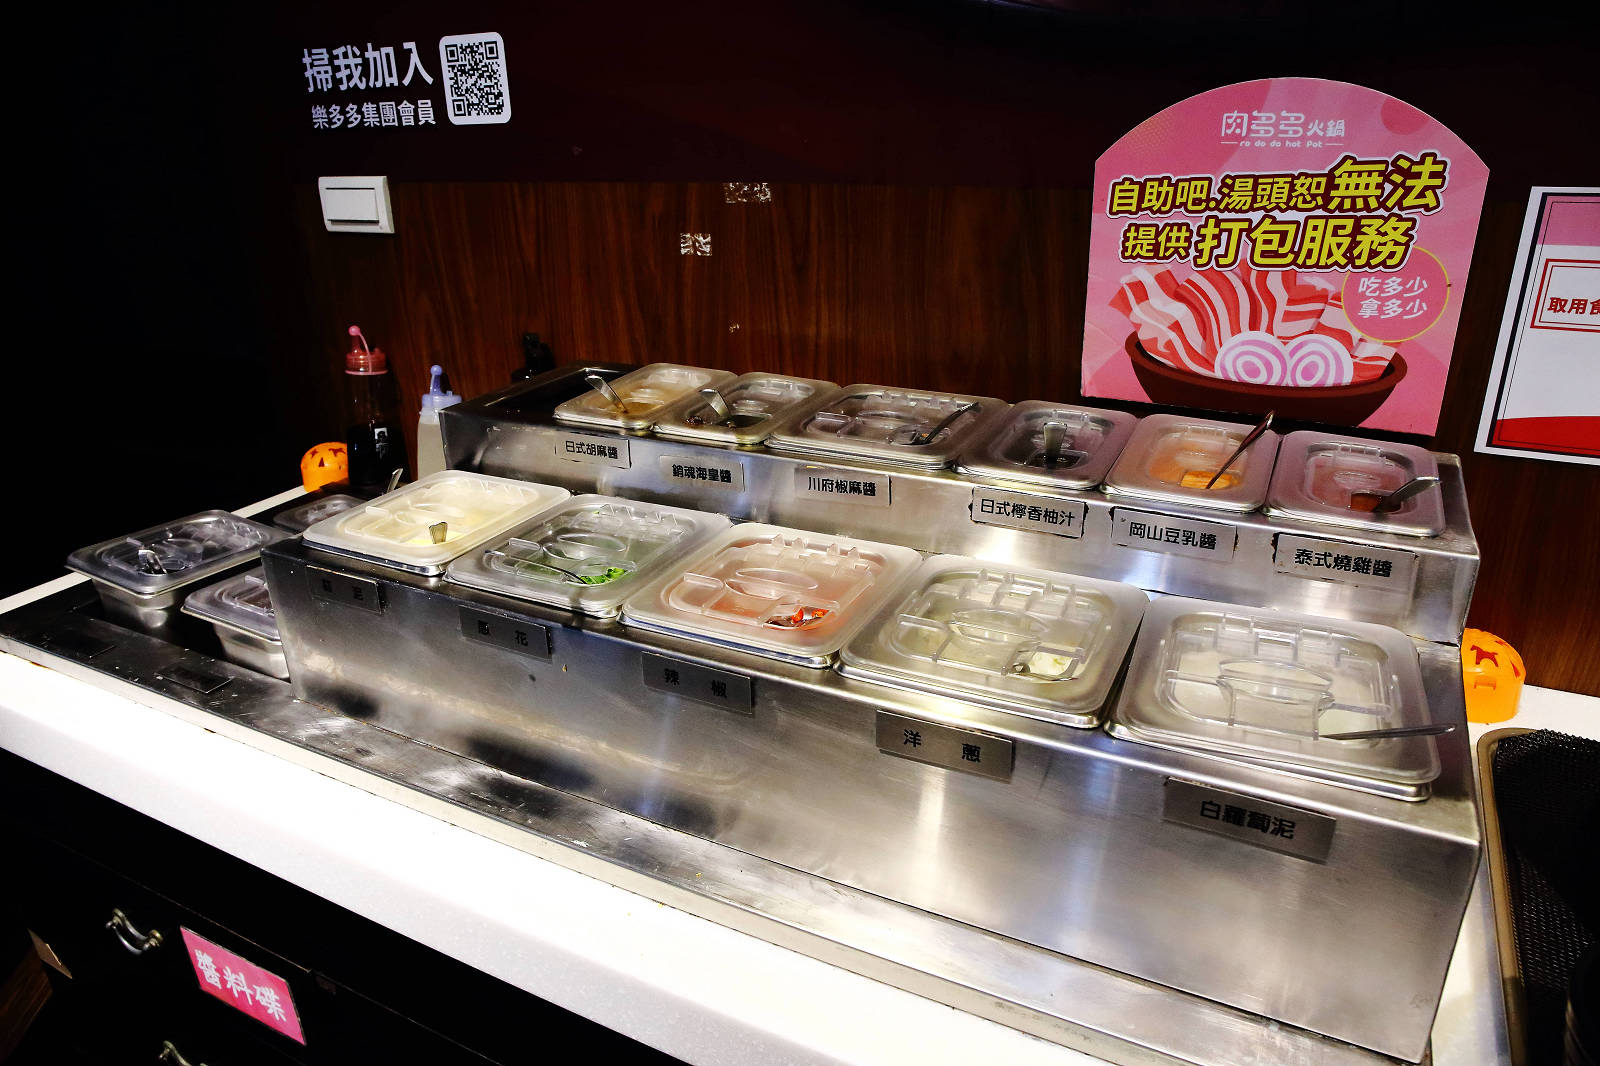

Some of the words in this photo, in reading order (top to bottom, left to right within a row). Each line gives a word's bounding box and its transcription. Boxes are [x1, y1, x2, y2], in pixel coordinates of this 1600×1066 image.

[302, 41, 434, 93] 掃我加入
[311, 99, 437, 129] 樂多多集團會員
[1221, 110, 1345, 137] 肉多多火鍋
[1121, 214, 1415, 269] 提供打包服務
[1359, 276, 1428, 297] 吃多少
[1358, 297, 1428, 320] 拿多少
[564, 440, 618, 459] 日式胡麻醬
[672, 463, 732, 484] 銷魂海皇醬
[807, 476, 876, 498] 川府椒麻醬
[1129, 522, 1217, 551] 岡山豆乳醬
[1295, 548, 1393, 578] 泰式燒雞醬
[194, 949, 287, 1022] 醬料碟
